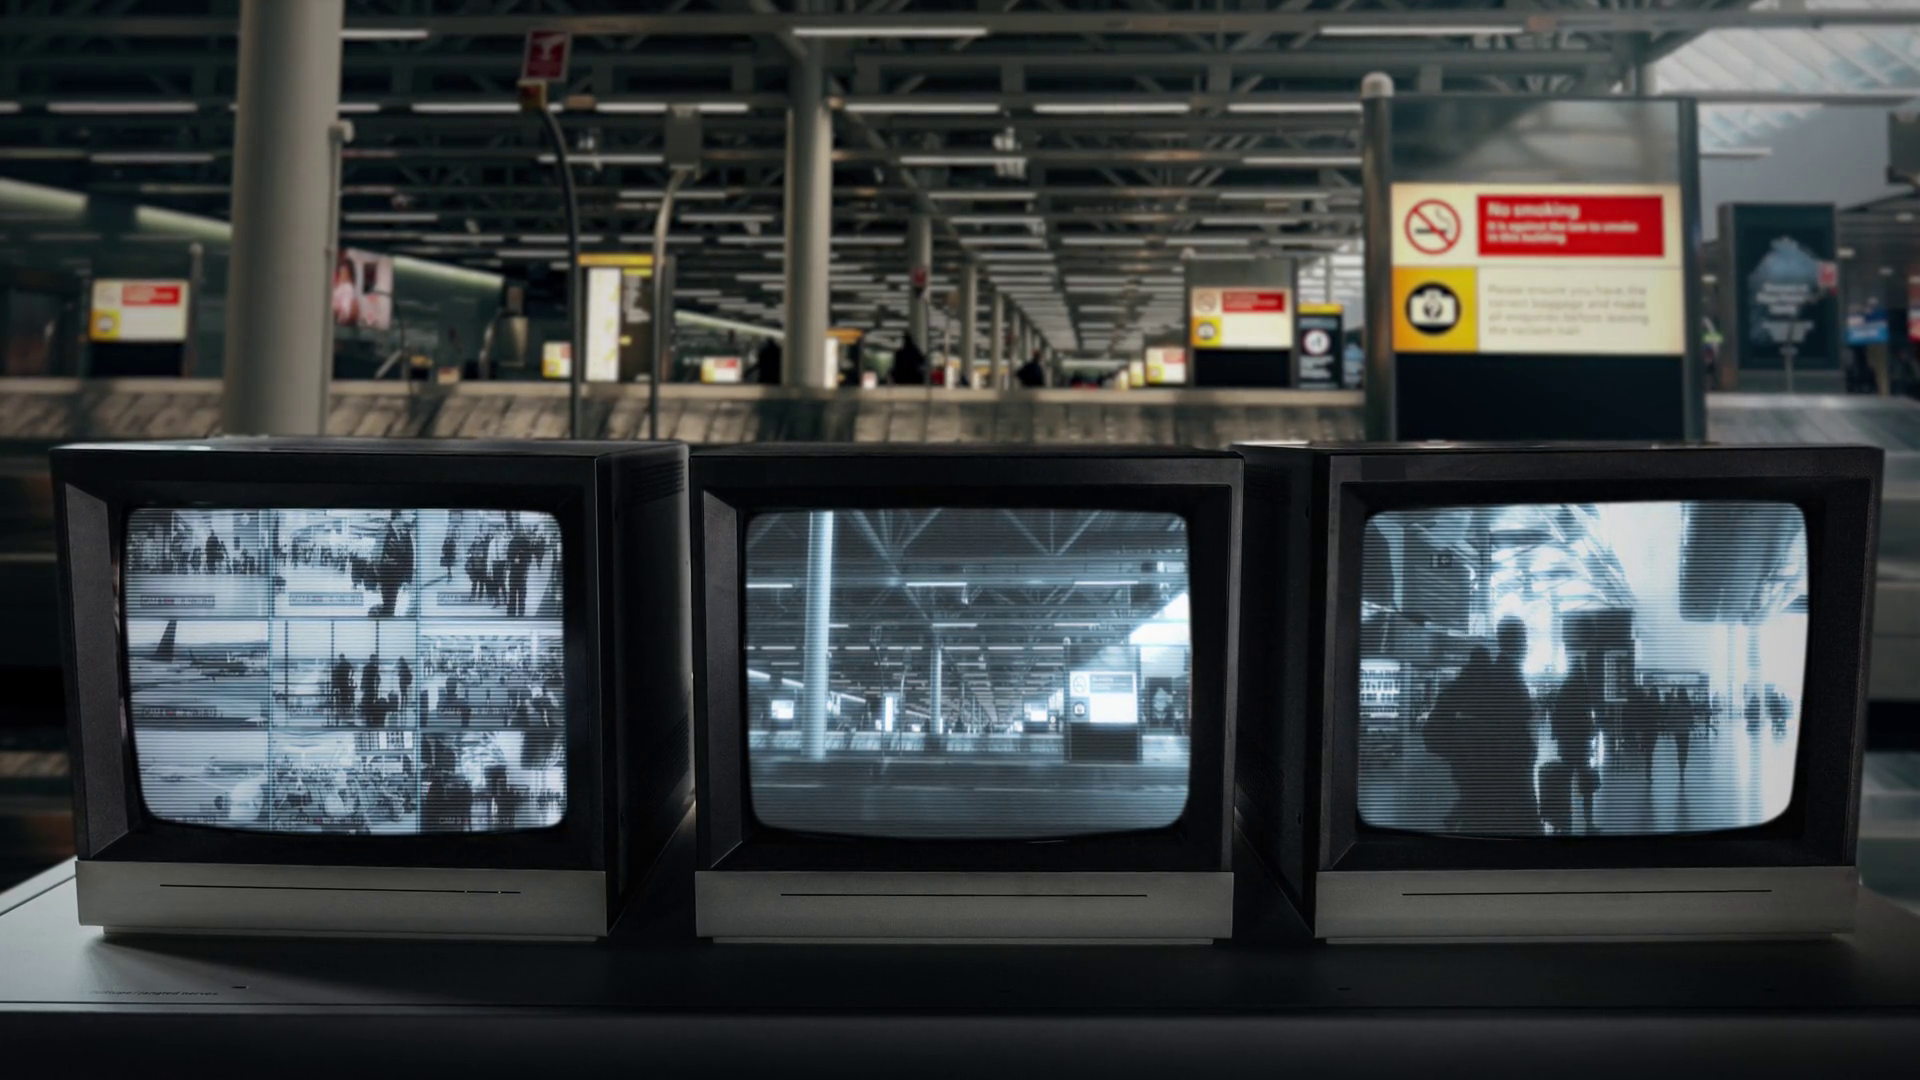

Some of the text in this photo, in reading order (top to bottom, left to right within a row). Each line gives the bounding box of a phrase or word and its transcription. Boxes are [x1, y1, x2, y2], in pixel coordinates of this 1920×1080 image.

[1487, 202, 1580, 220] No smoking
[1508, 221, 1546, 235] against
[1548, 221, 1566, 233] the
[1588, 221, 1601, 233] to
[1603, 221, 1638, 233] smoke
